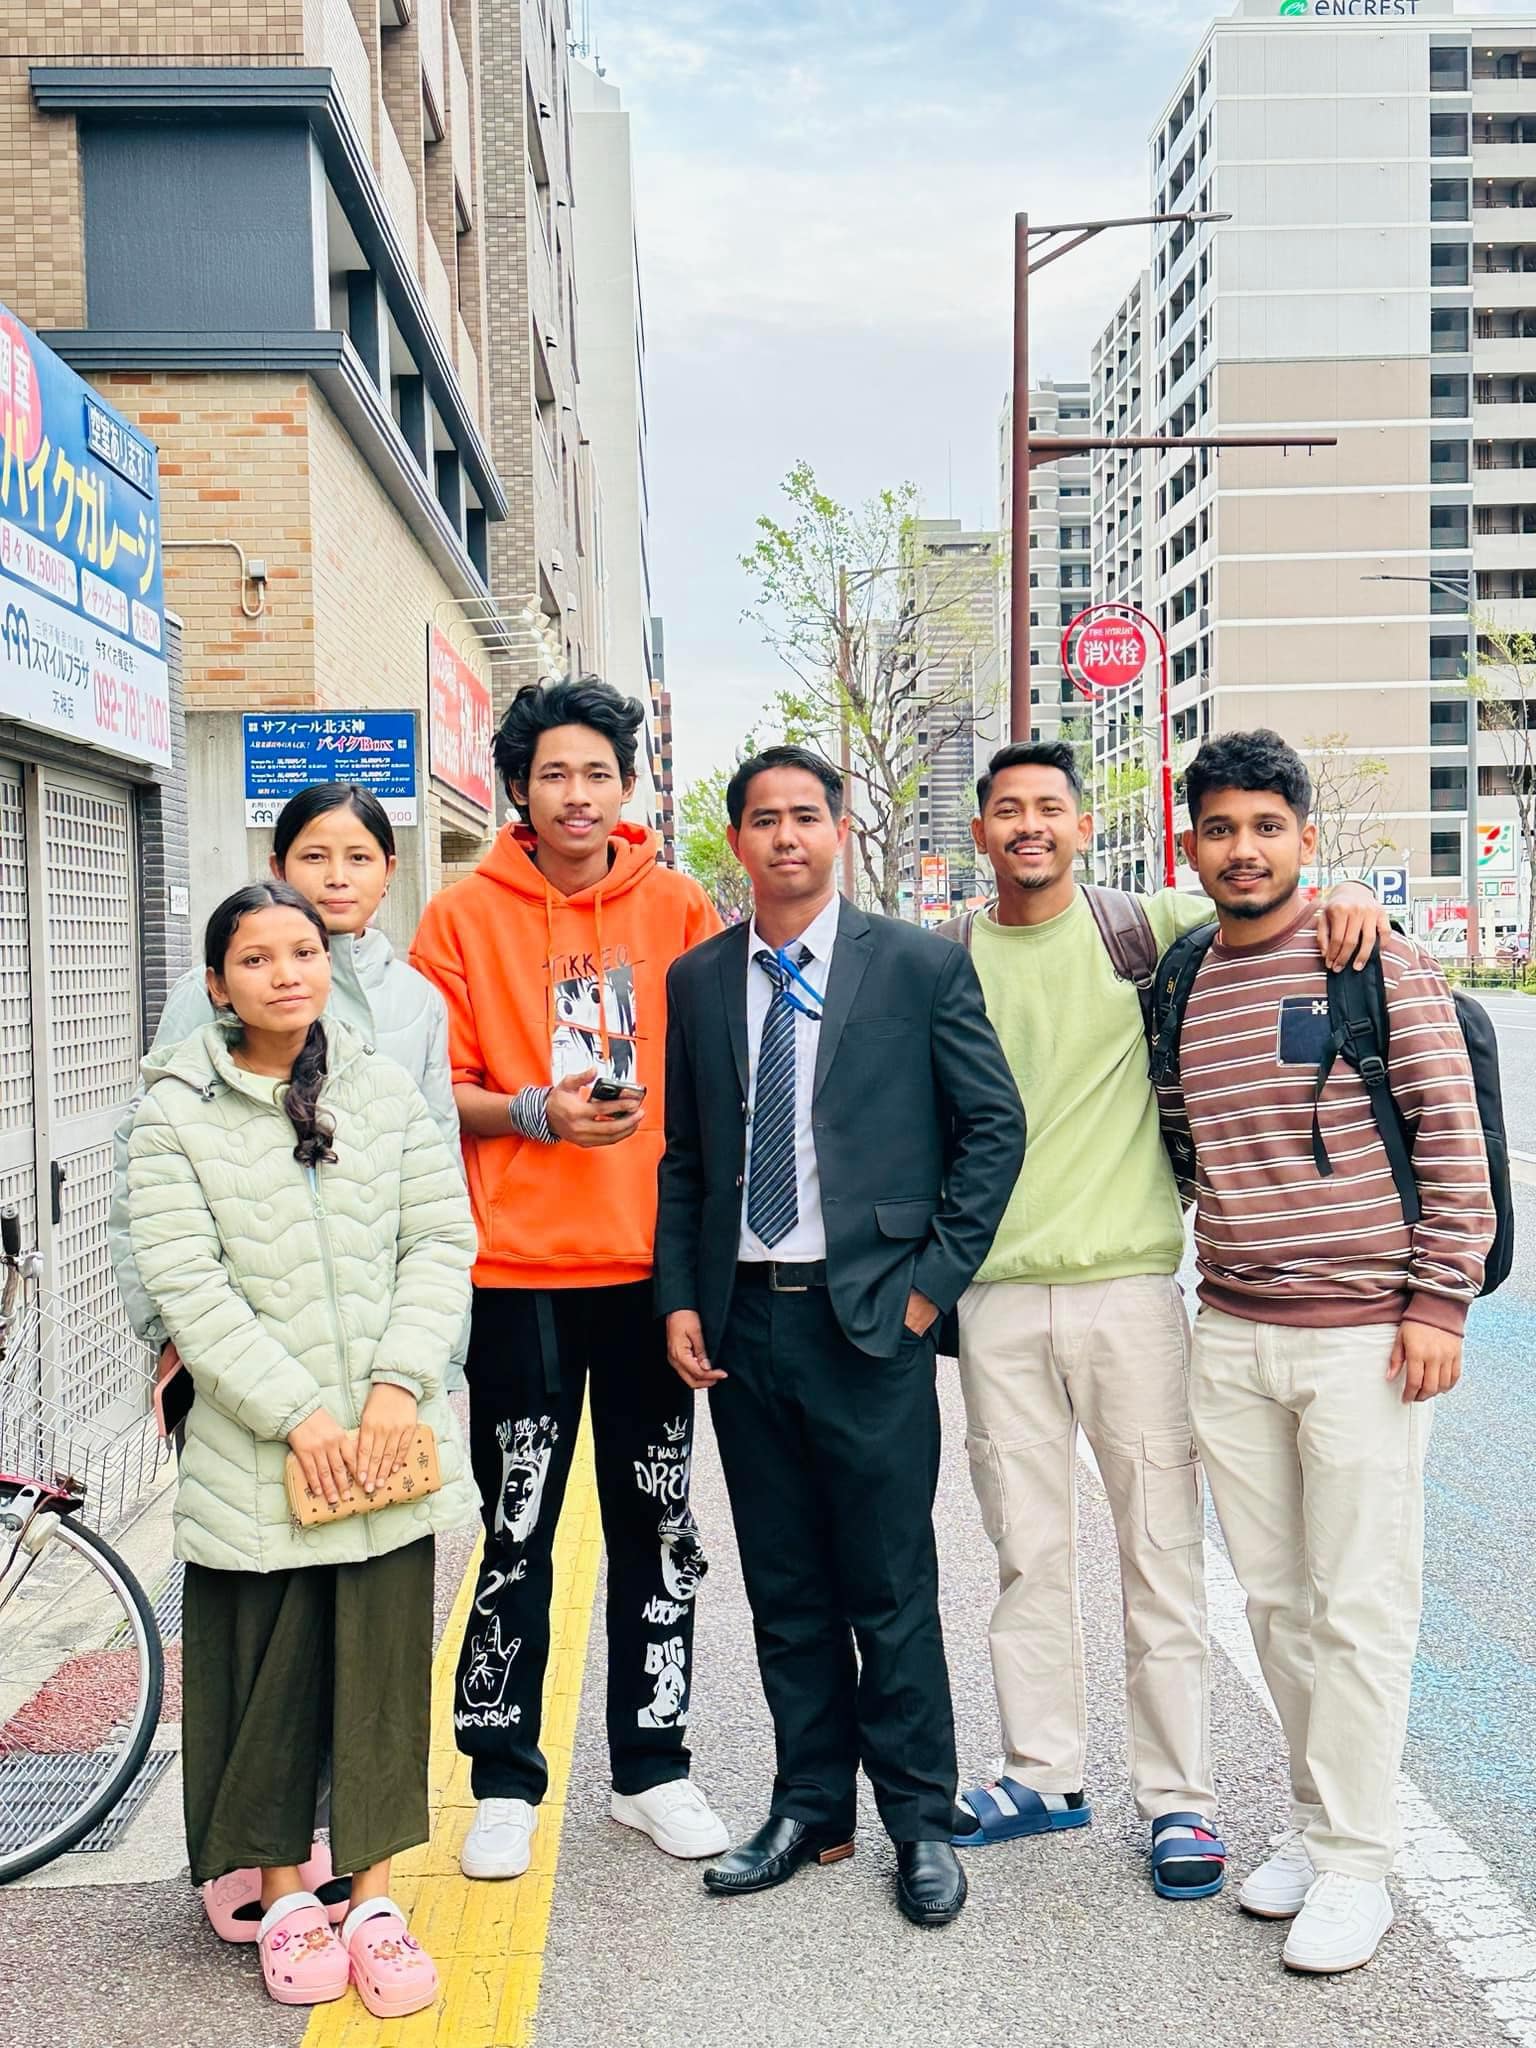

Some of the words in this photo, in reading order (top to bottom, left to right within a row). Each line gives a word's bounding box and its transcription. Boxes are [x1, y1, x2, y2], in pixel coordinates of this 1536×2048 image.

[0, 410, 156, 597] バイクガレージ
[32, 637, 90, 690] スマイルプラザ
[1083, 638, 1141, 667] 消火栓
[93, 670, 169, 751] 092-781-1000
[261, 719, 366, 734] サフィール北天神
[1378, 870, 1402, 904] P
[1385, 894, 1403, 904] 24h
[643, 1635, 686, 1675] BIG
